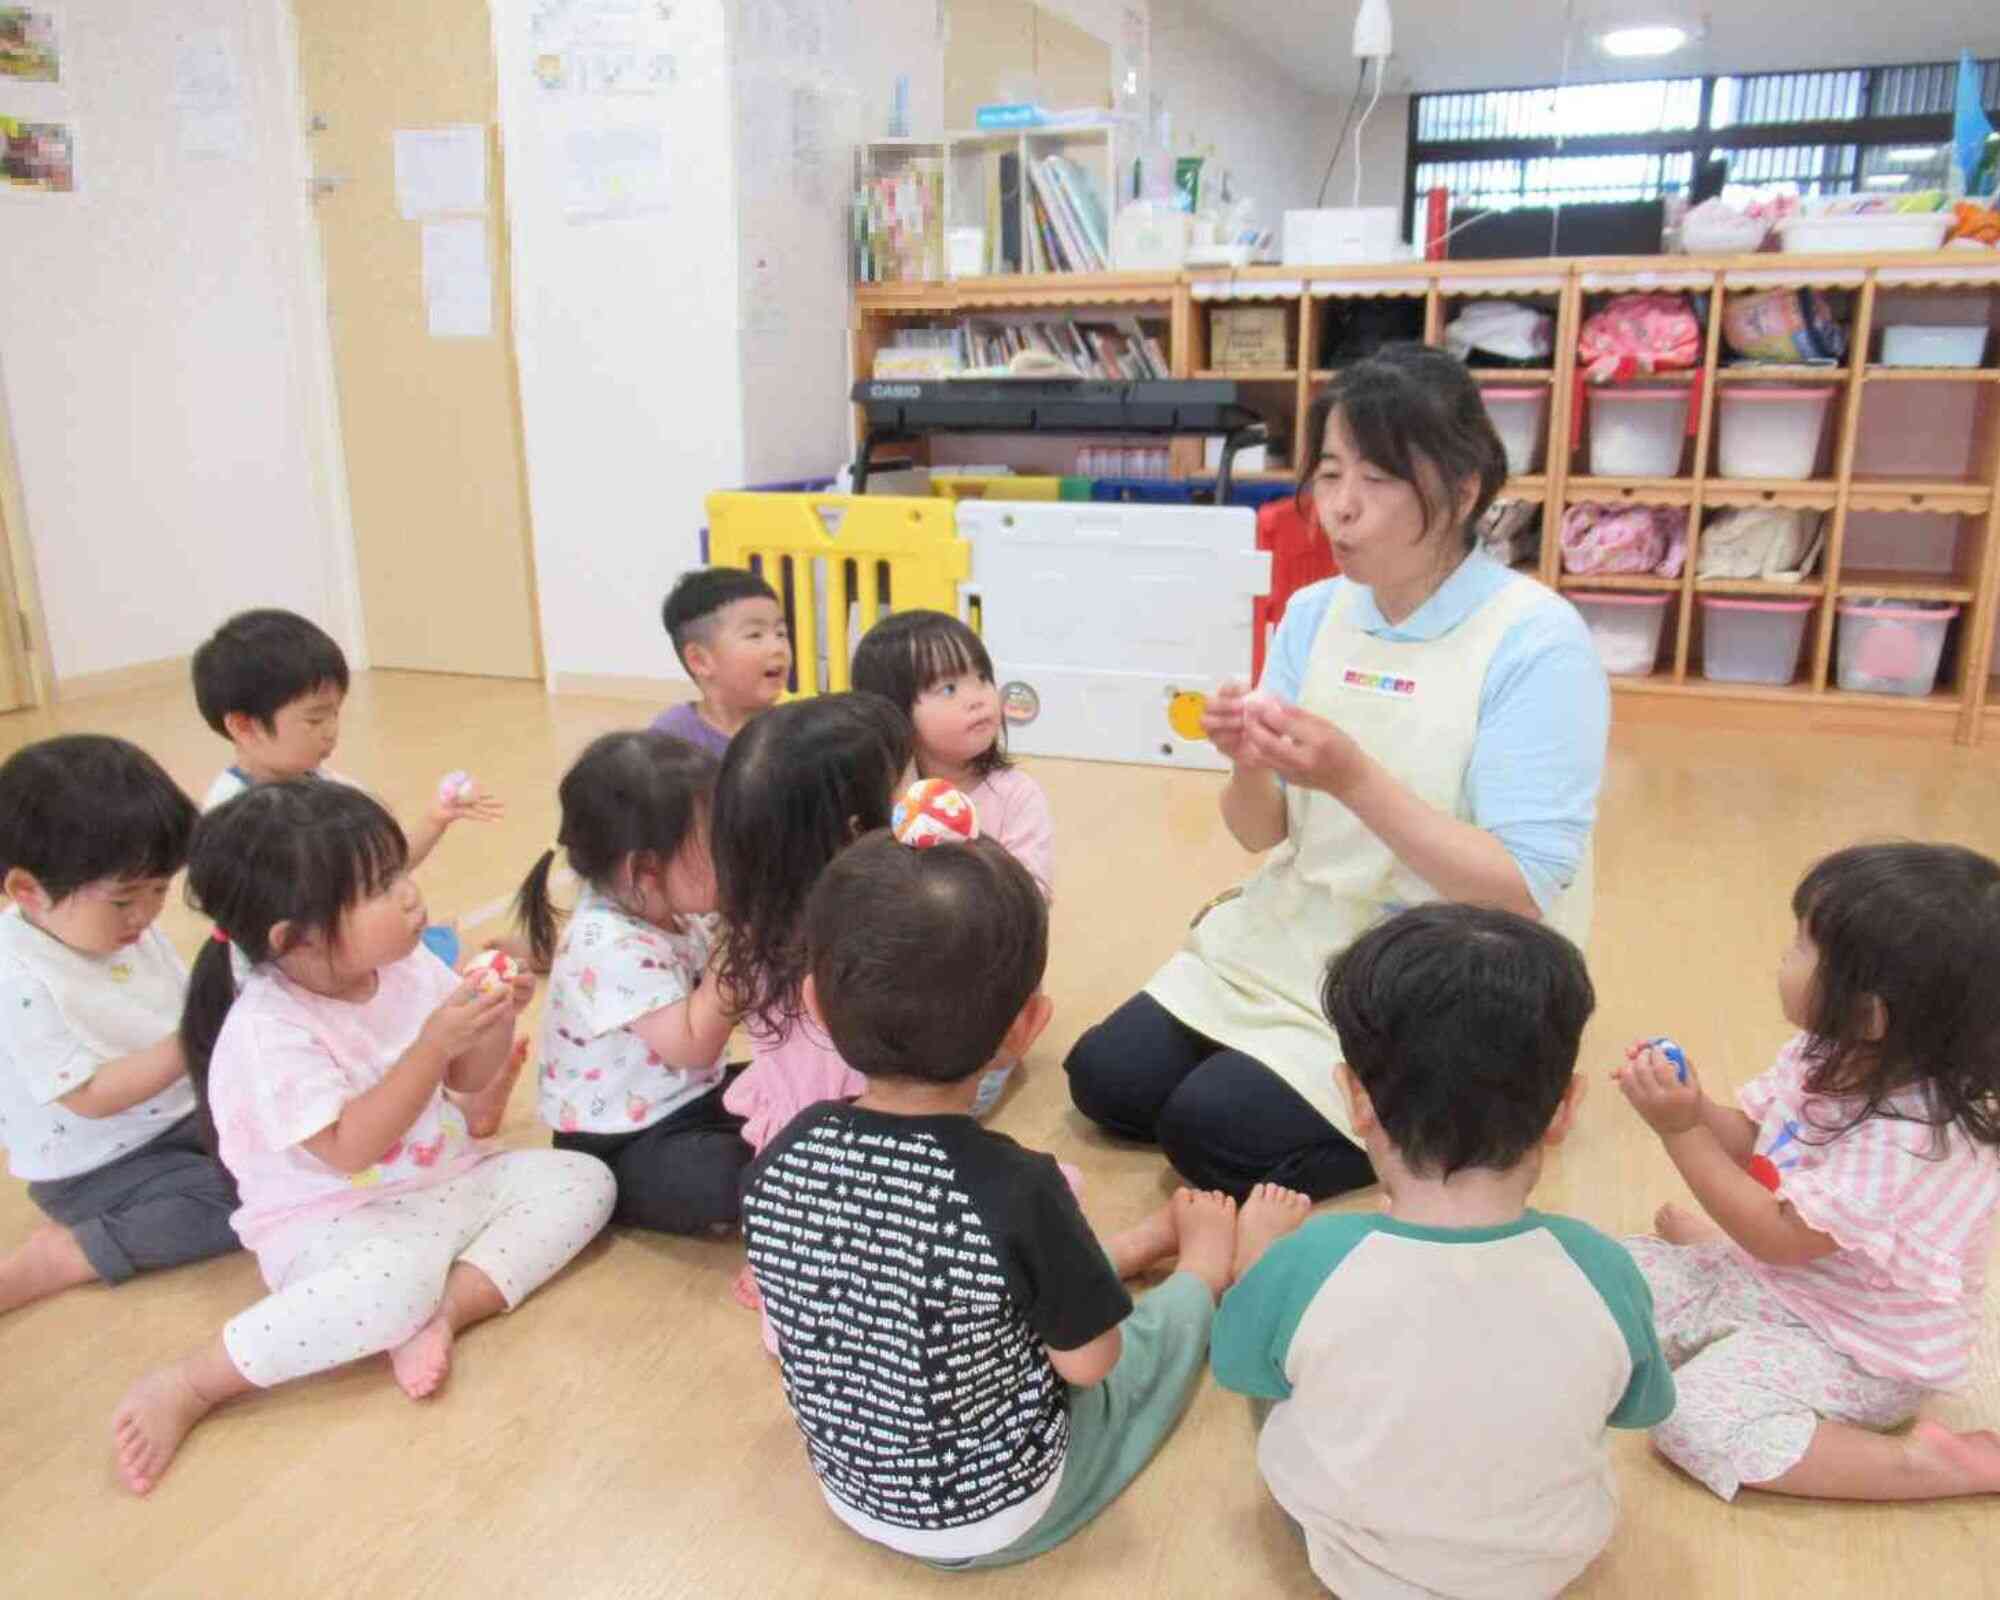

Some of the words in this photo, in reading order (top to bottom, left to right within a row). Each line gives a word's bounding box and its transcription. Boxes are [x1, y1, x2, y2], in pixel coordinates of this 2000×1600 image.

[870, 385, 921, 399] CASIO
[934, 1244, 955, 1258] you
[957, 1250, 977, 1263] are
[948, 1266, 974, 1280] who
